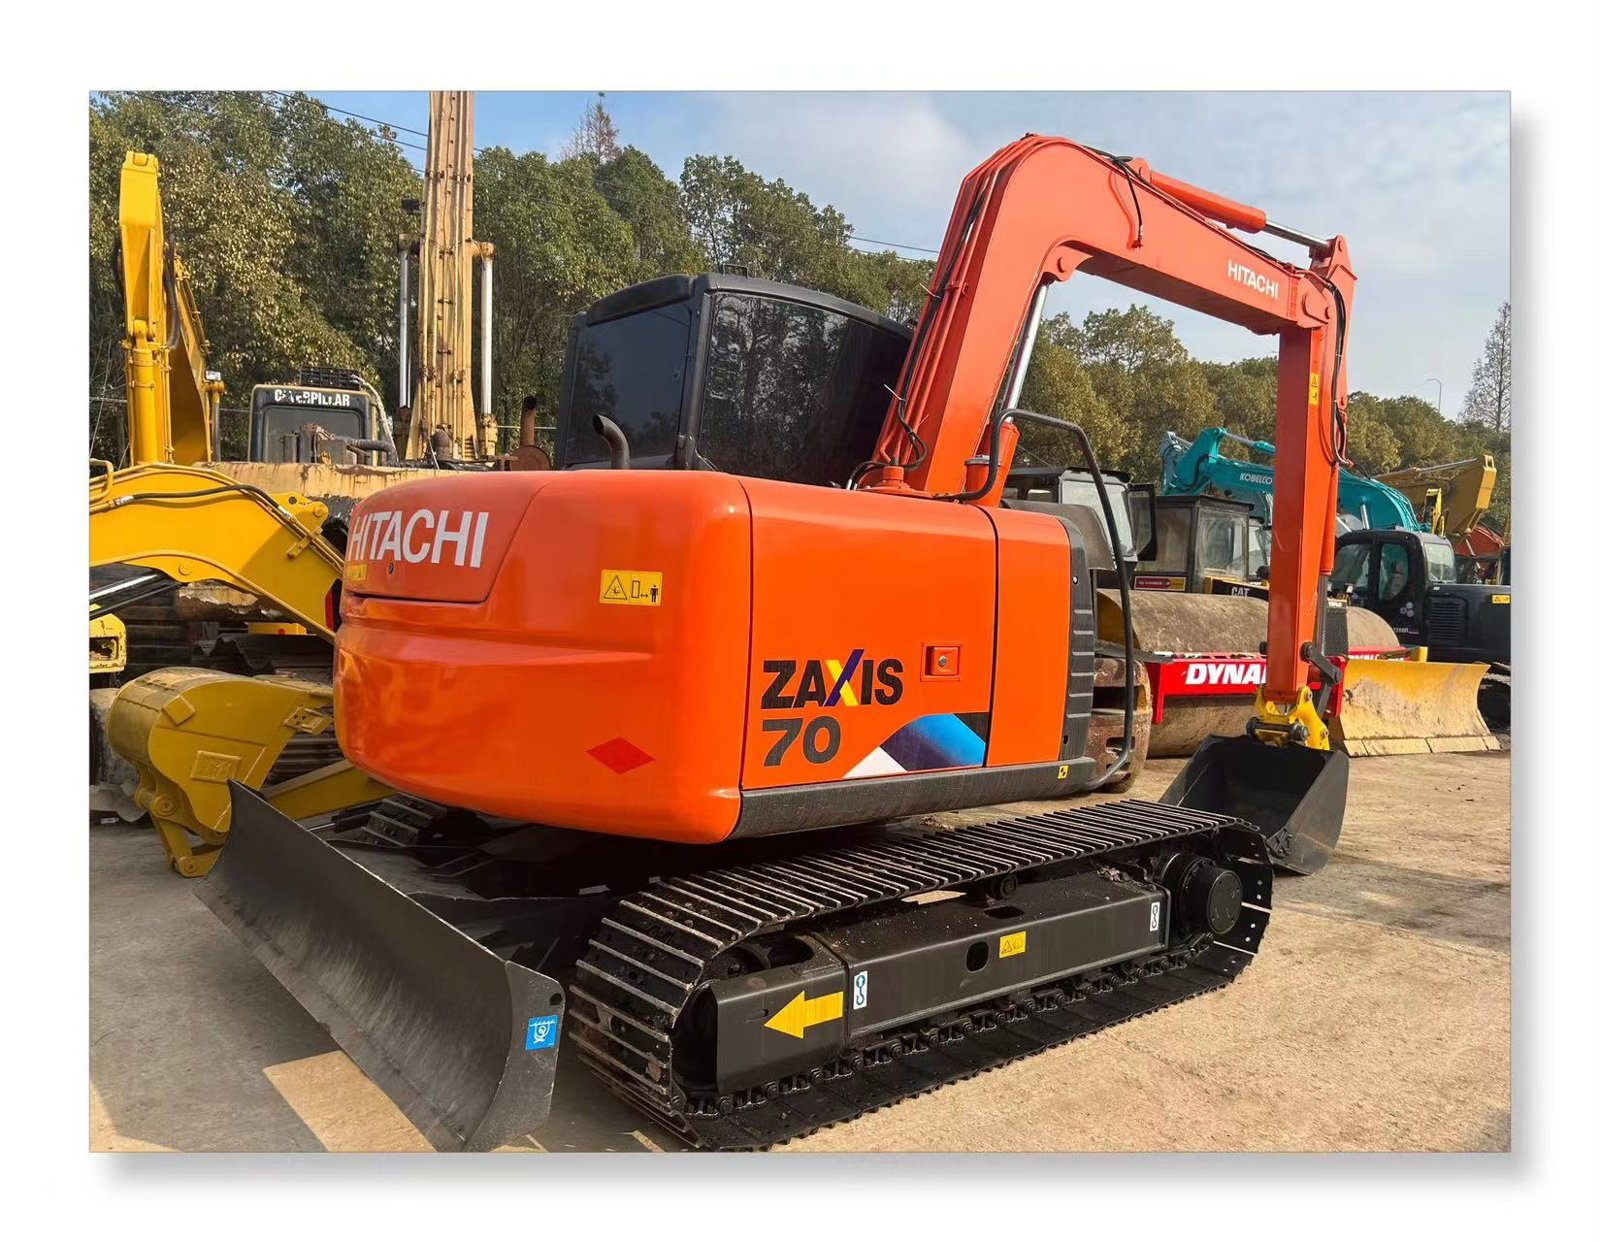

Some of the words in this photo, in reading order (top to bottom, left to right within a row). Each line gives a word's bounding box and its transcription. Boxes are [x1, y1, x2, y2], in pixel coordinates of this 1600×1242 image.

[1227, 259, 1279, 300] HITACHI
[1240, 472, 1273, 485] KOBELCO
[348, 508, 489, 568] HITACHI
[1231, 586, 1250, 597] CAT
[761, 649, 904, 709] ZAXIS
[762, 715, 841, 767] 70
